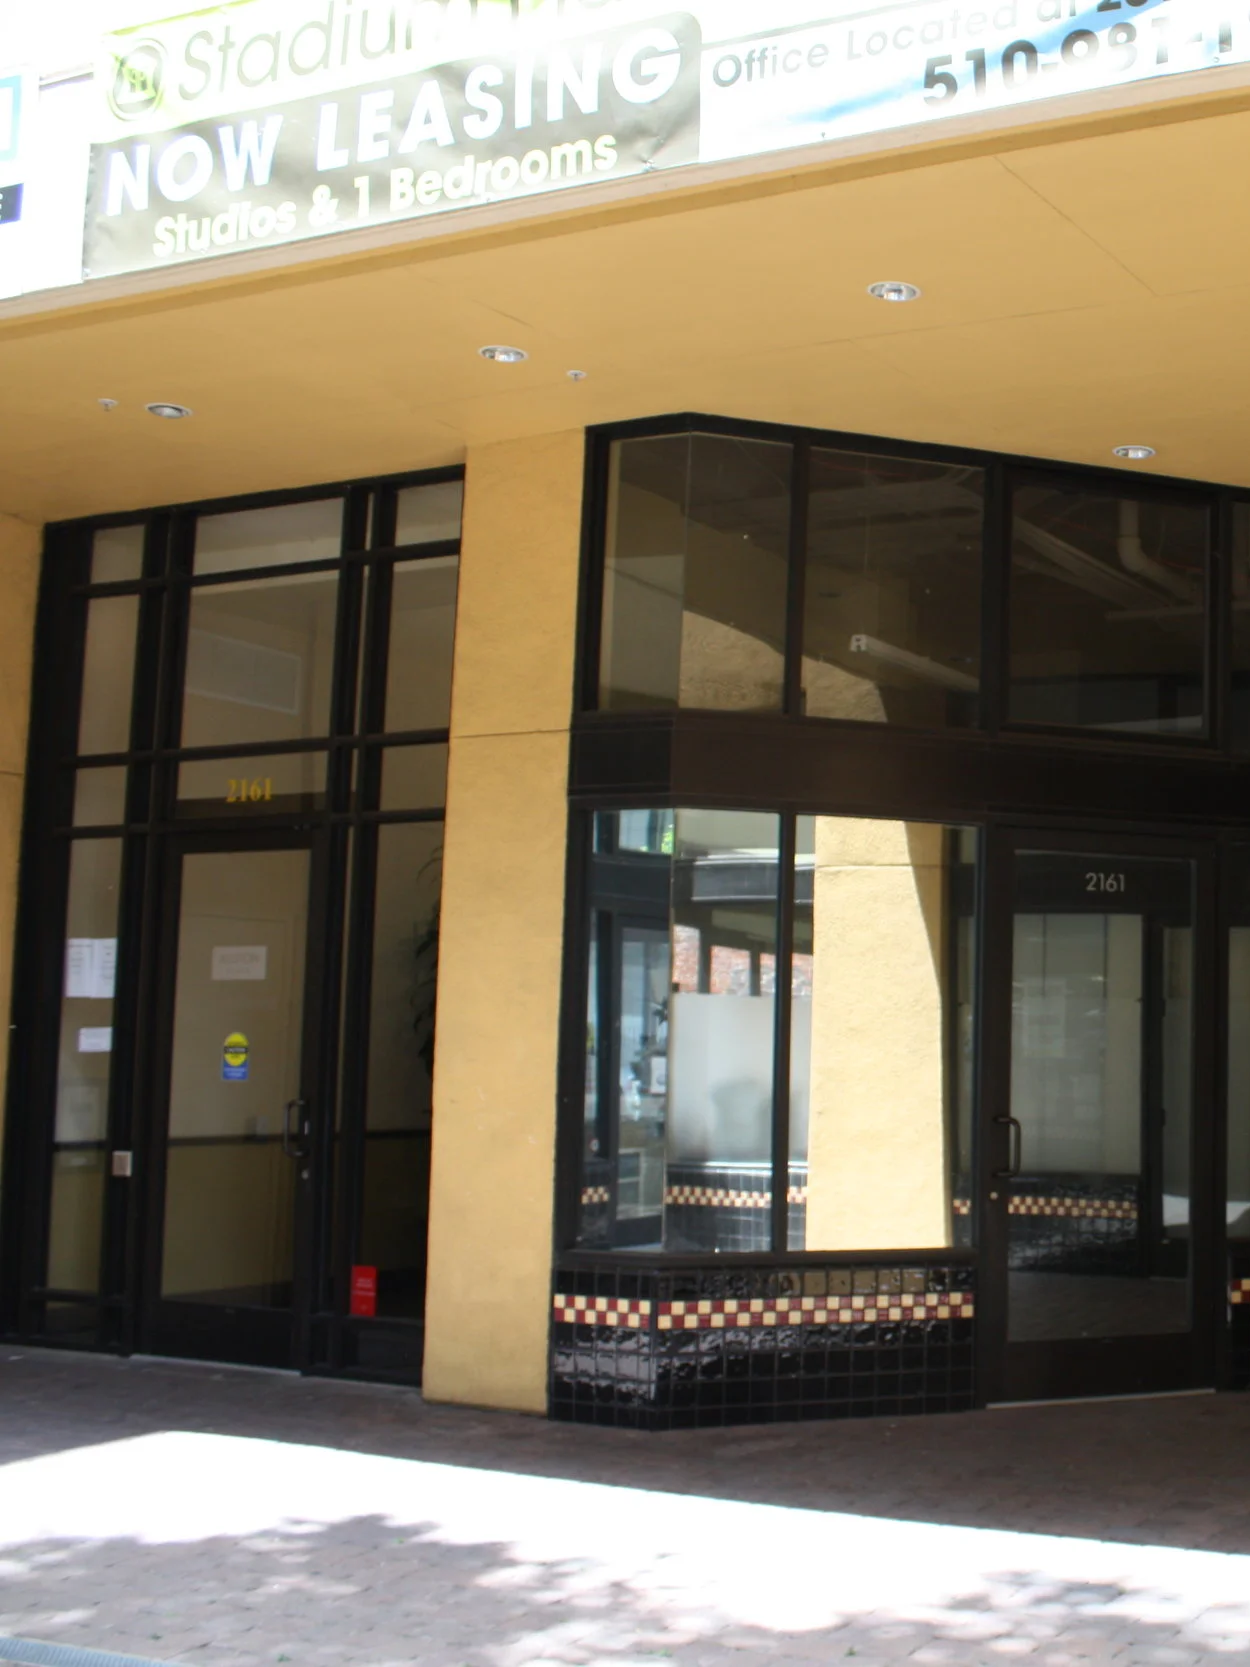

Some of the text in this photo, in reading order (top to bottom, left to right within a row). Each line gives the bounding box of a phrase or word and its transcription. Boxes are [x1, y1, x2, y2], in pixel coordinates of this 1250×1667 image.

[712, 43, 830, 88] Office
[846, 0, 1018, 61] Located
[105, 28, 682, 217] NOW LEASING
[152, 134, 619, 258] Studios & 1 Bedrooms
[226, 776, 272, 803] 2161
[1084, 872, 1125, 893] 2161
